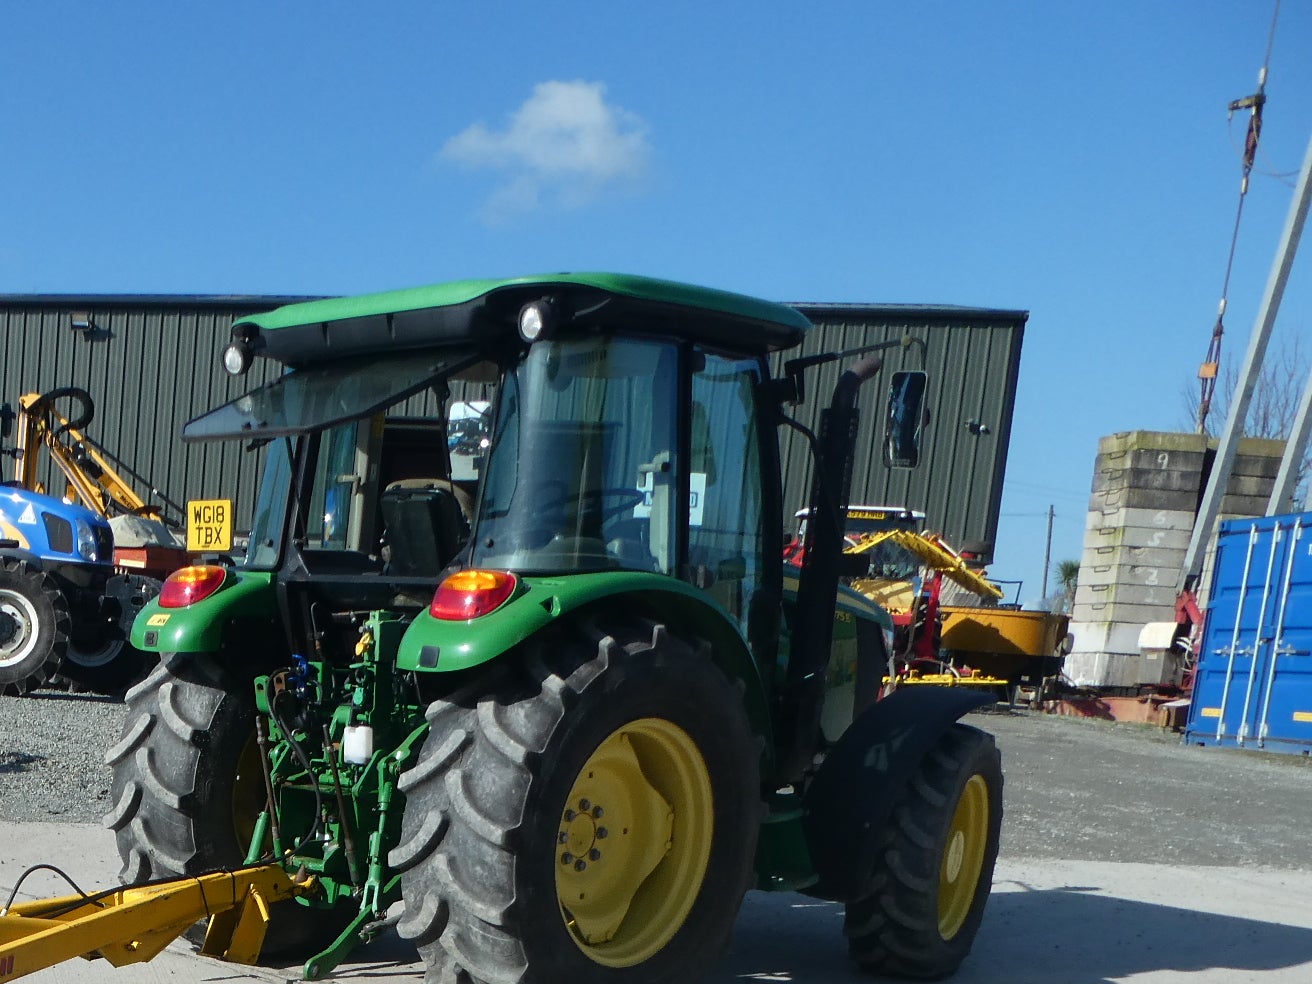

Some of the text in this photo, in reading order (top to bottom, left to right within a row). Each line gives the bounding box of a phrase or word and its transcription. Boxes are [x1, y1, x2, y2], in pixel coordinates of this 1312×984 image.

[1157, 453, 1169, 470] 9
[194, 505, 225, 524] WG18
[195, 526, 223, 545] TBX
